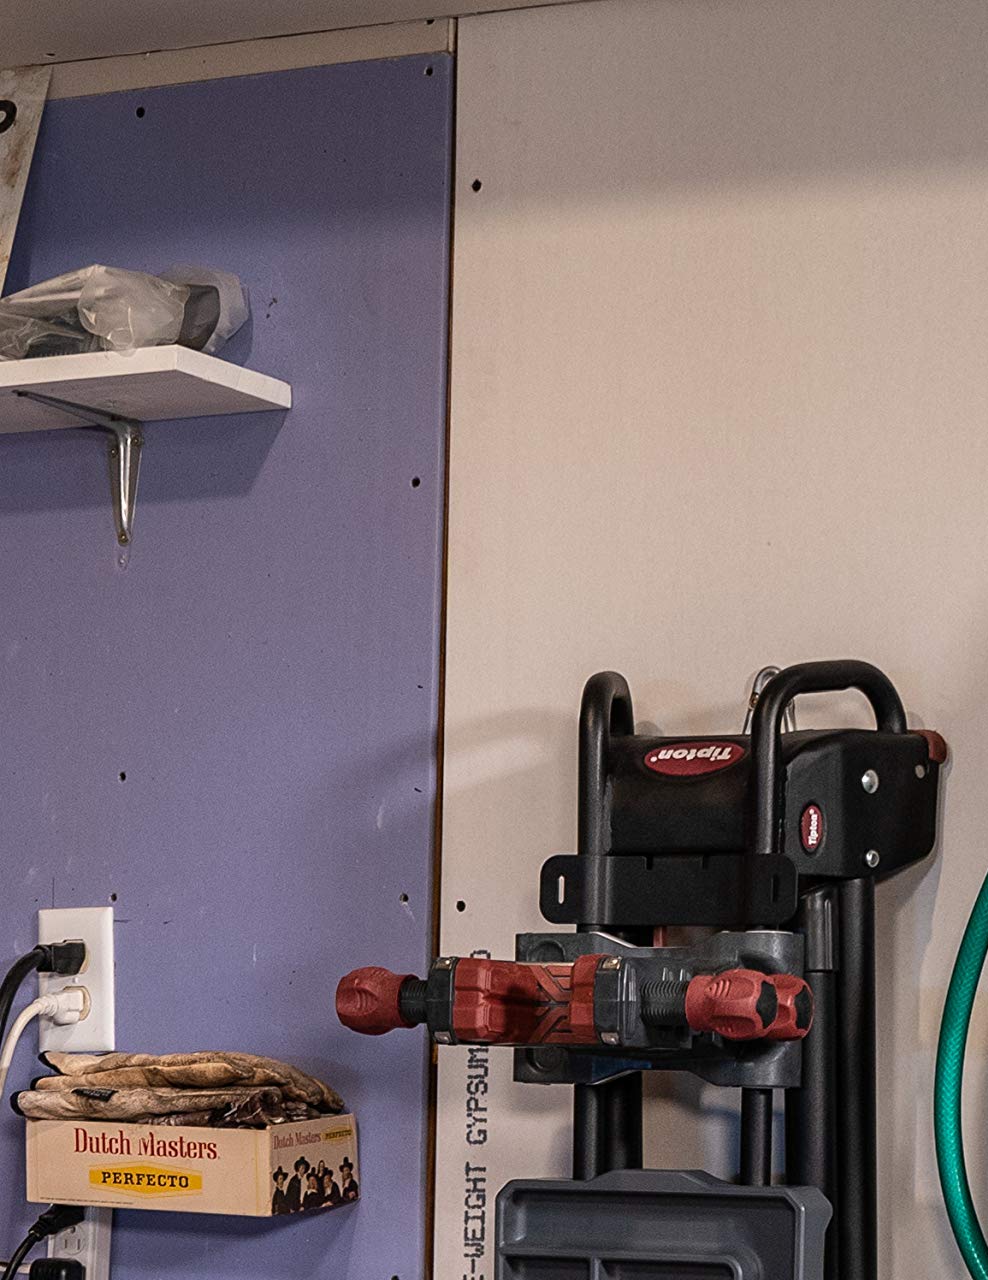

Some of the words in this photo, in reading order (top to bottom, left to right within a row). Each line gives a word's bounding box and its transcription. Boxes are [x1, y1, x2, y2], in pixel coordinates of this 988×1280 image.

[466, 1048, 489, 1145] GYPSUM
[74, 1127, 131, 1155] Dutch
[138, 1131, 218, 1160] Masters
[273, 1133, 294, 1150] Dutch
[295, 1131, 322, 1147] Masters
[101, 1171, 189, 1188] PERFECTO
